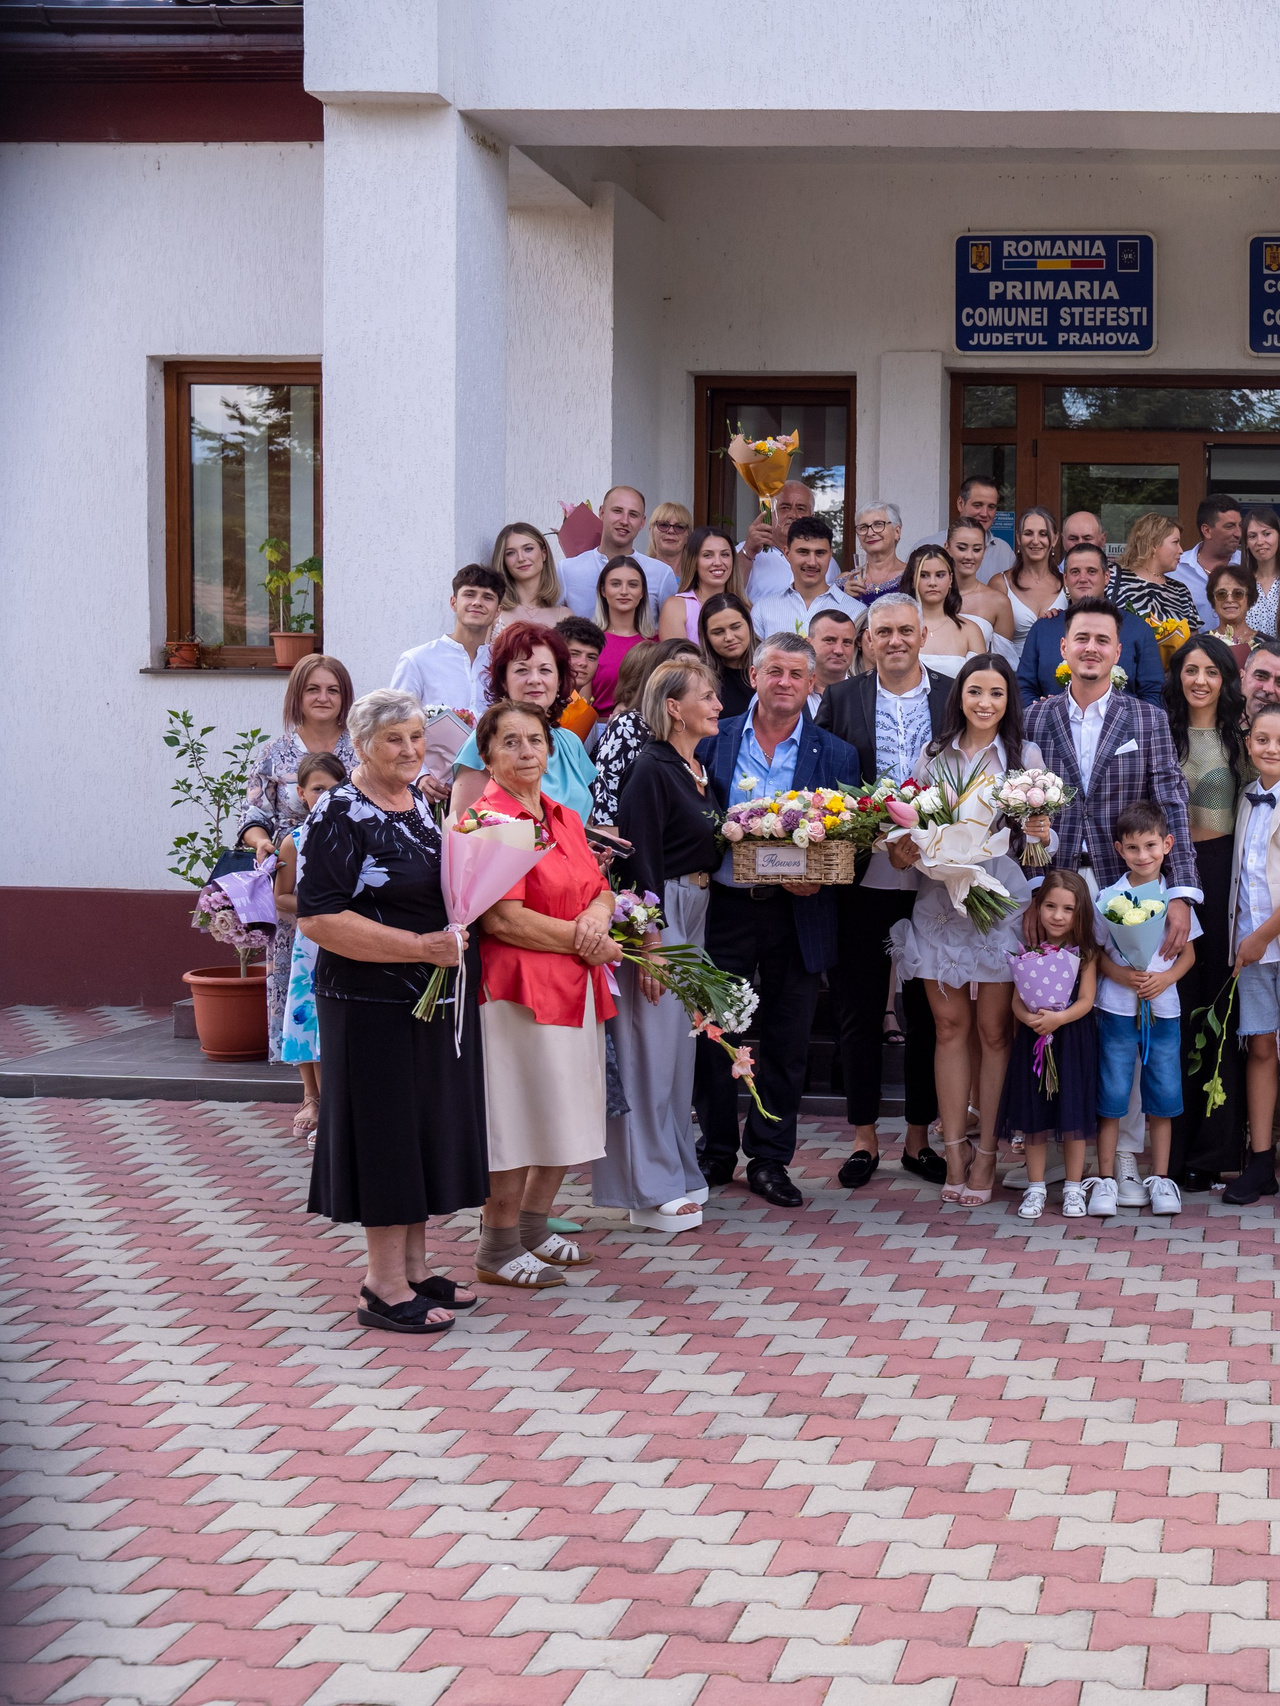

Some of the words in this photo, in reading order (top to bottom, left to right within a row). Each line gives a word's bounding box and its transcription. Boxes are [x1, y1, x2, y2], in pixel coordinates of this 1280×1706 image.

[1003, 240, 1106, 257] ROMANIA
[989, 281, 1120, 300] PRIMARIA
[961, 307, 1048, 327] COMUNEI
[1059, 307, 1148, 326] STEFESTI
[969, 333, 1048, 345] JUDETUL
[1058, 332, 1140, 345] PRAHOVA
[762, 853, 801, 868] Flowers
